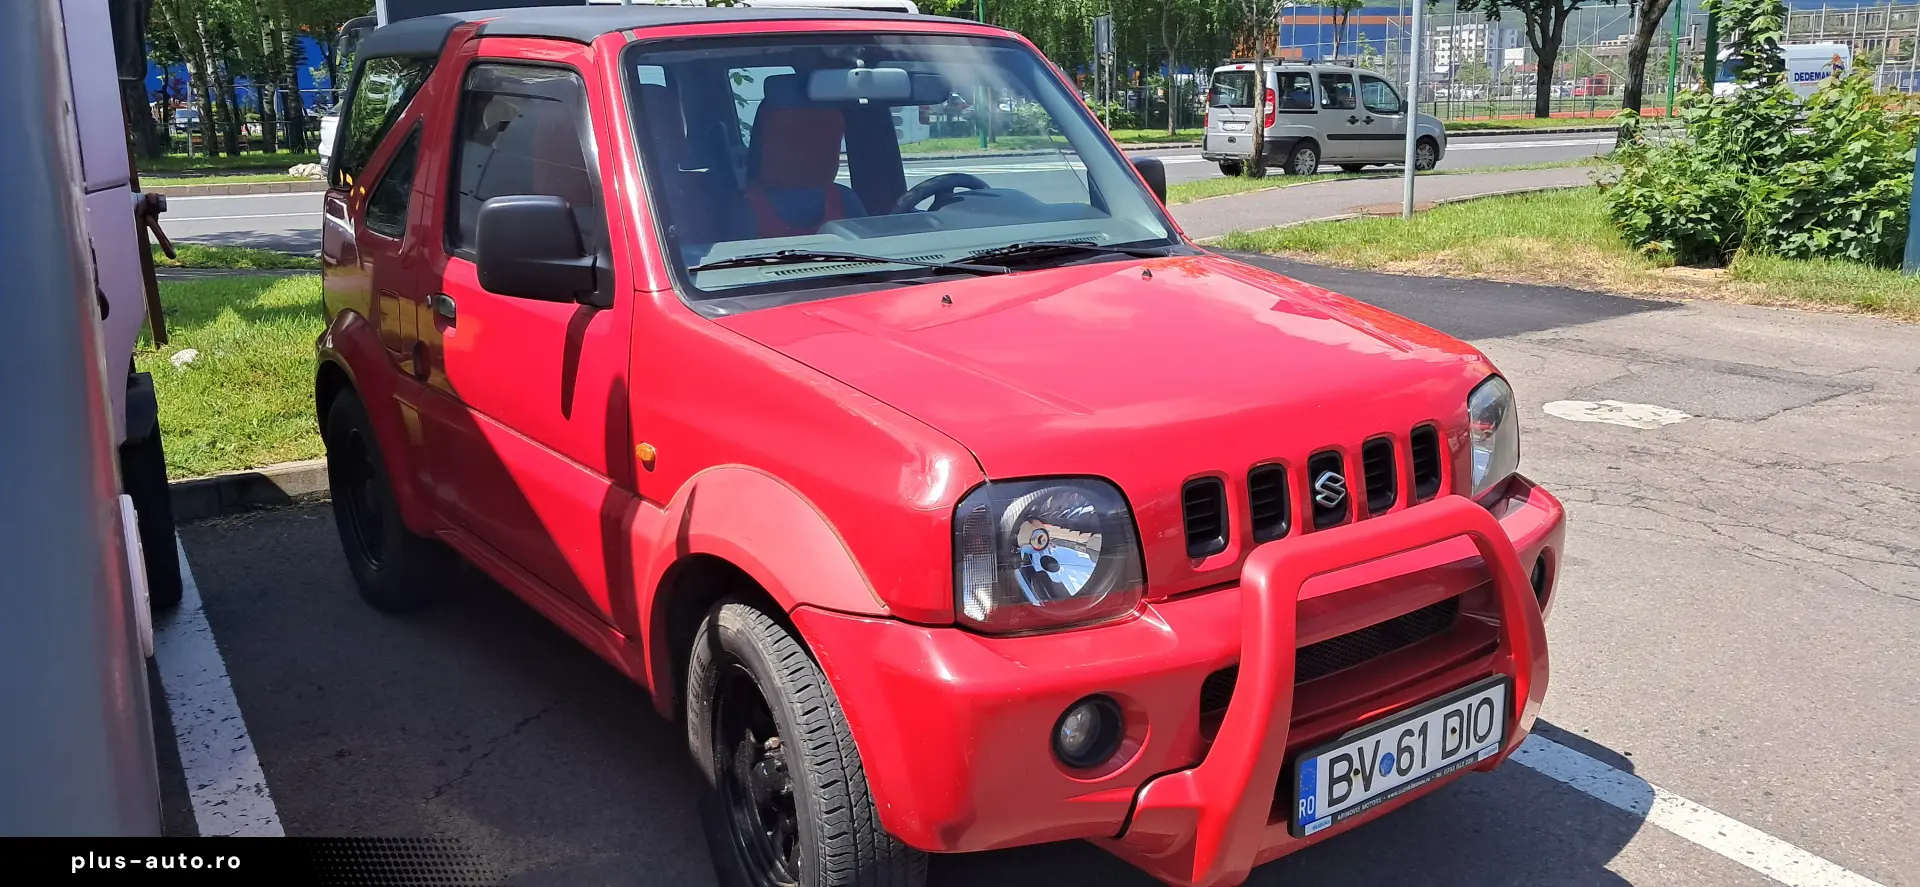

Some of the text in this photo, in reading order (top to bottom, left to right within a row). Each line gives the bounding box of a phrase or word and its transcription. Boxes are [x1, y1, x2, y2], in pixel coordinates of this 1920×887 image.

[1327, 697, 1495, 808] BV 61 DIO
[1299, 795, 1315, 819] RO
[1362, 797, 1382, 811] MOTORS
